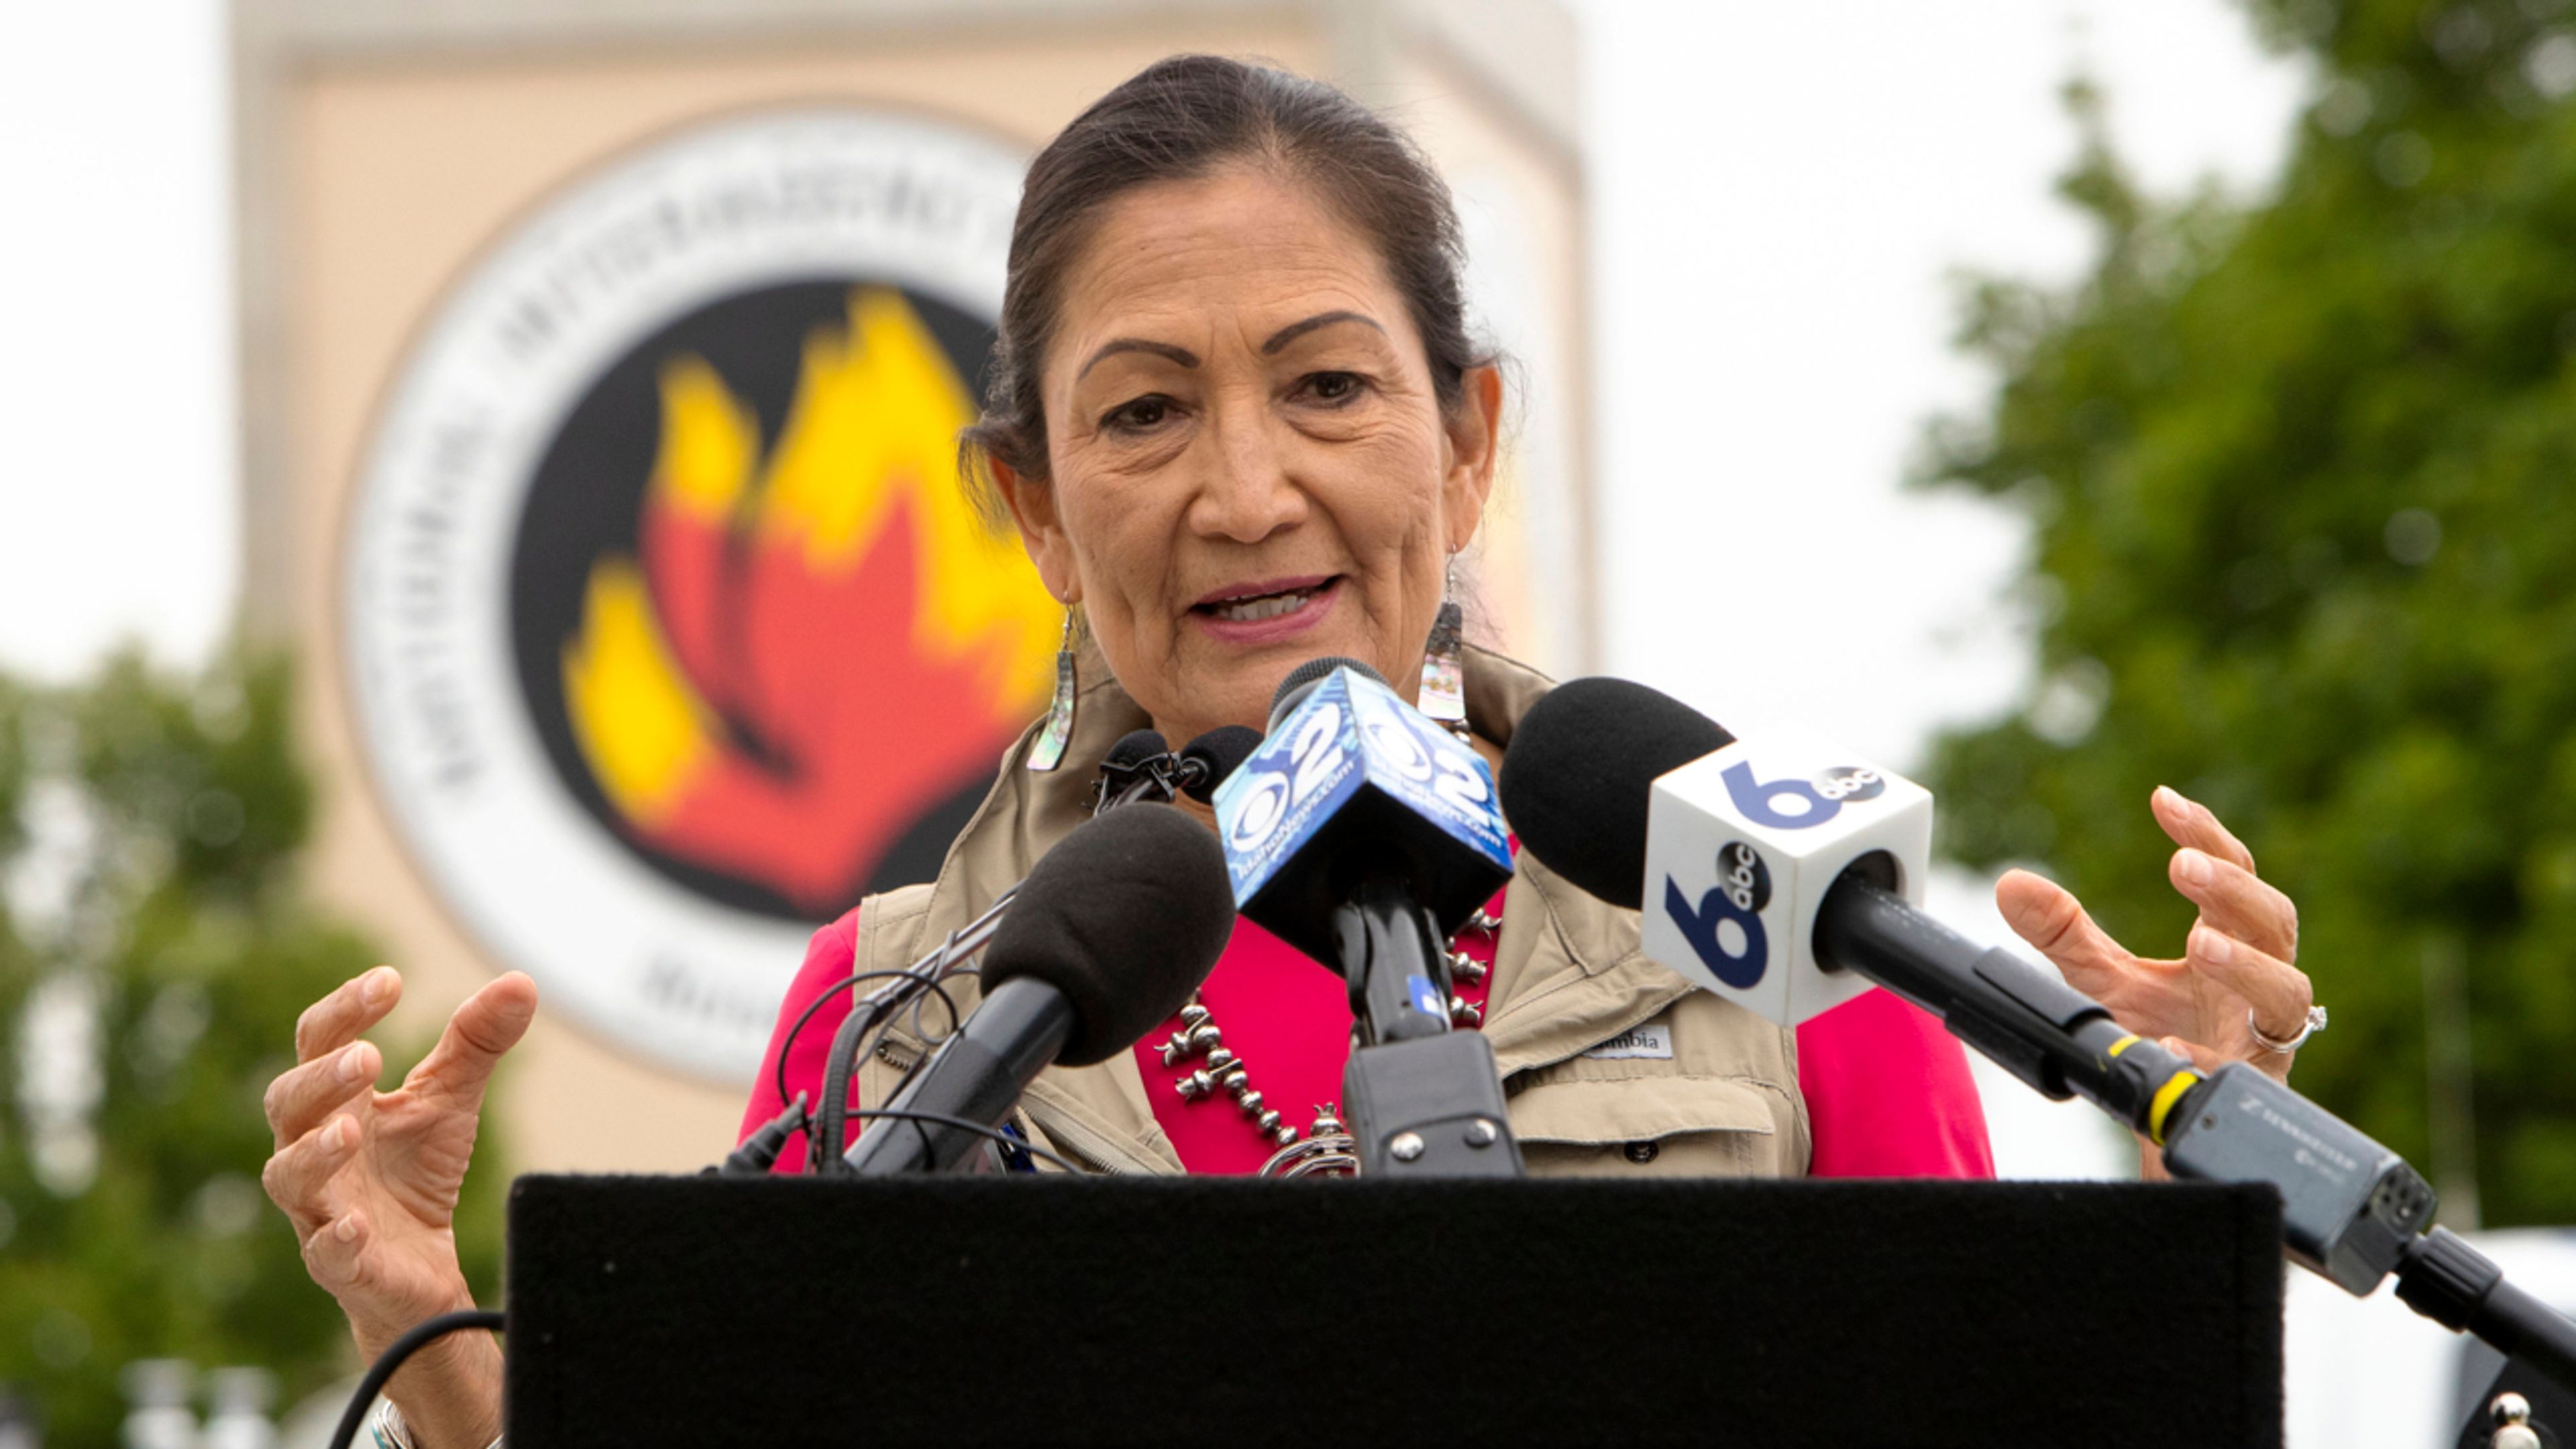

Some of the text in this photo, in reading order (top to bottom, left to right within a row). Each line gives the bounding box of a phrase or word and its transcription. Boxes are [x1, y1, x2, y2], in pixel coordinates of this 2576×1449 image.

[1291, 702, 1344, 808] 2
[1434, 748, 1491, 828] 2
[1720, 759, 1880, 830] 6 abc
[1664, 843, 1768, 990] 6 abc
